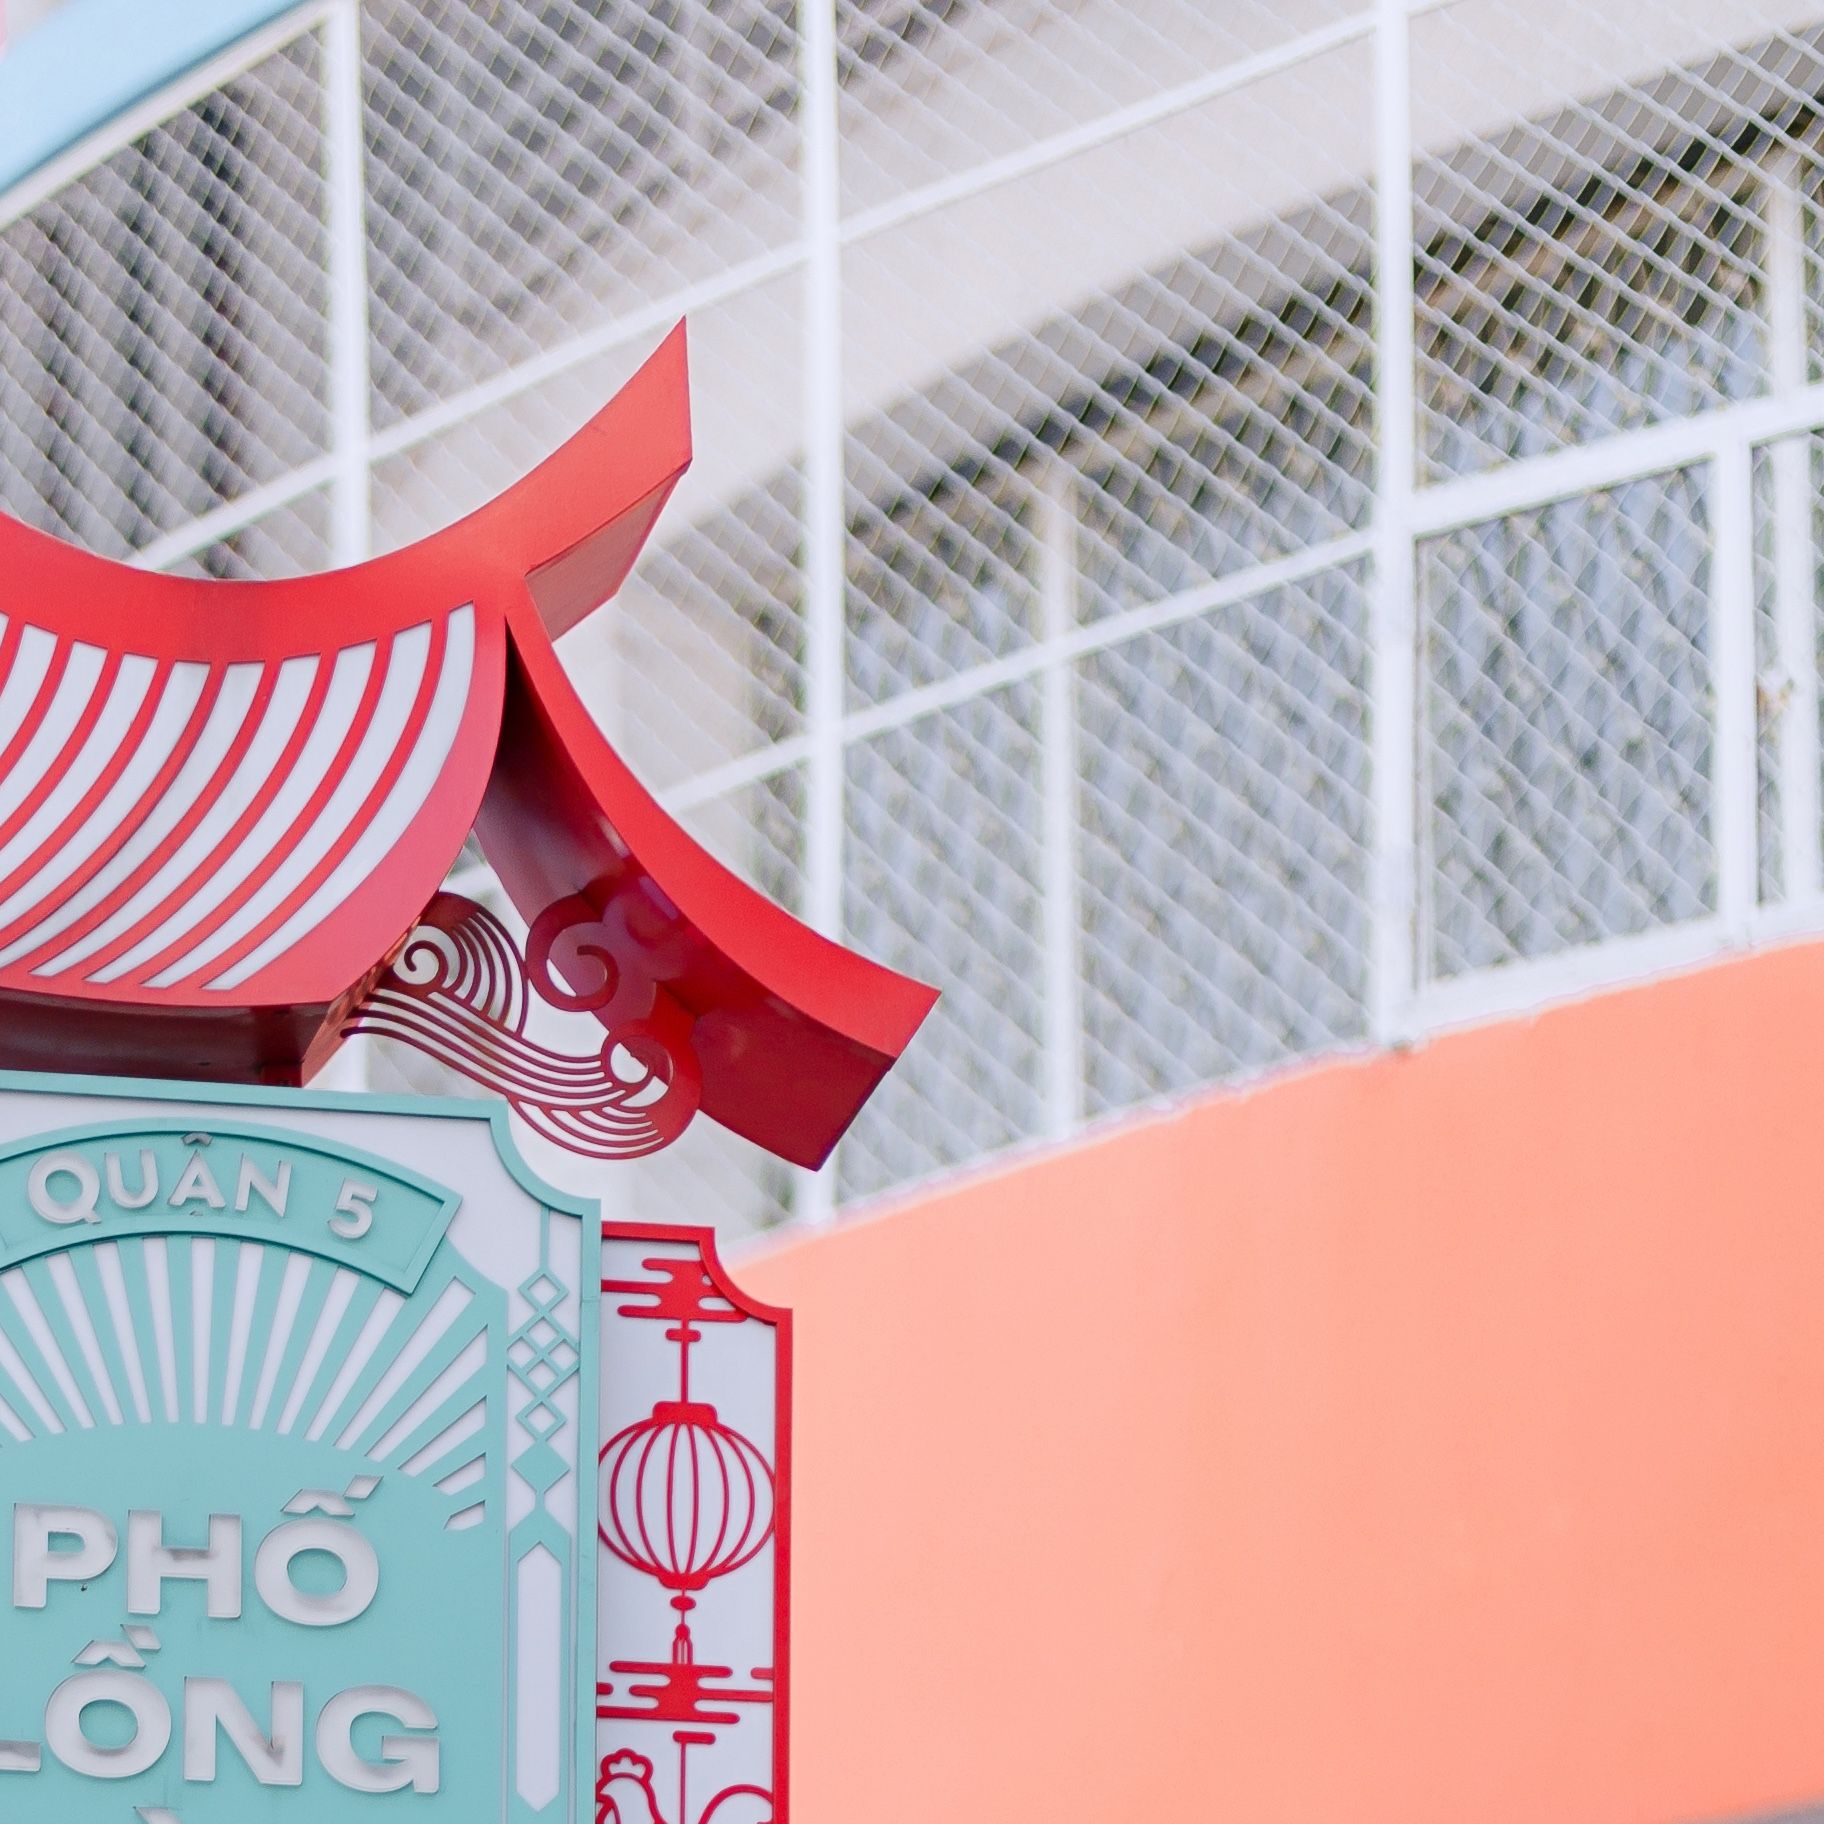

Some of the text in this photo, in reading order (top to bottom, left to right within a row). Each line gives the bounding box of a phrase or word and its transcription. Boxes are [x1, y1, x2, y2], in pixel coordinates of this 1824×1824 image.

[27, 1131, 379, 1240] QUẬN 5
[12, 1474, 384, 1627] PHỐ
